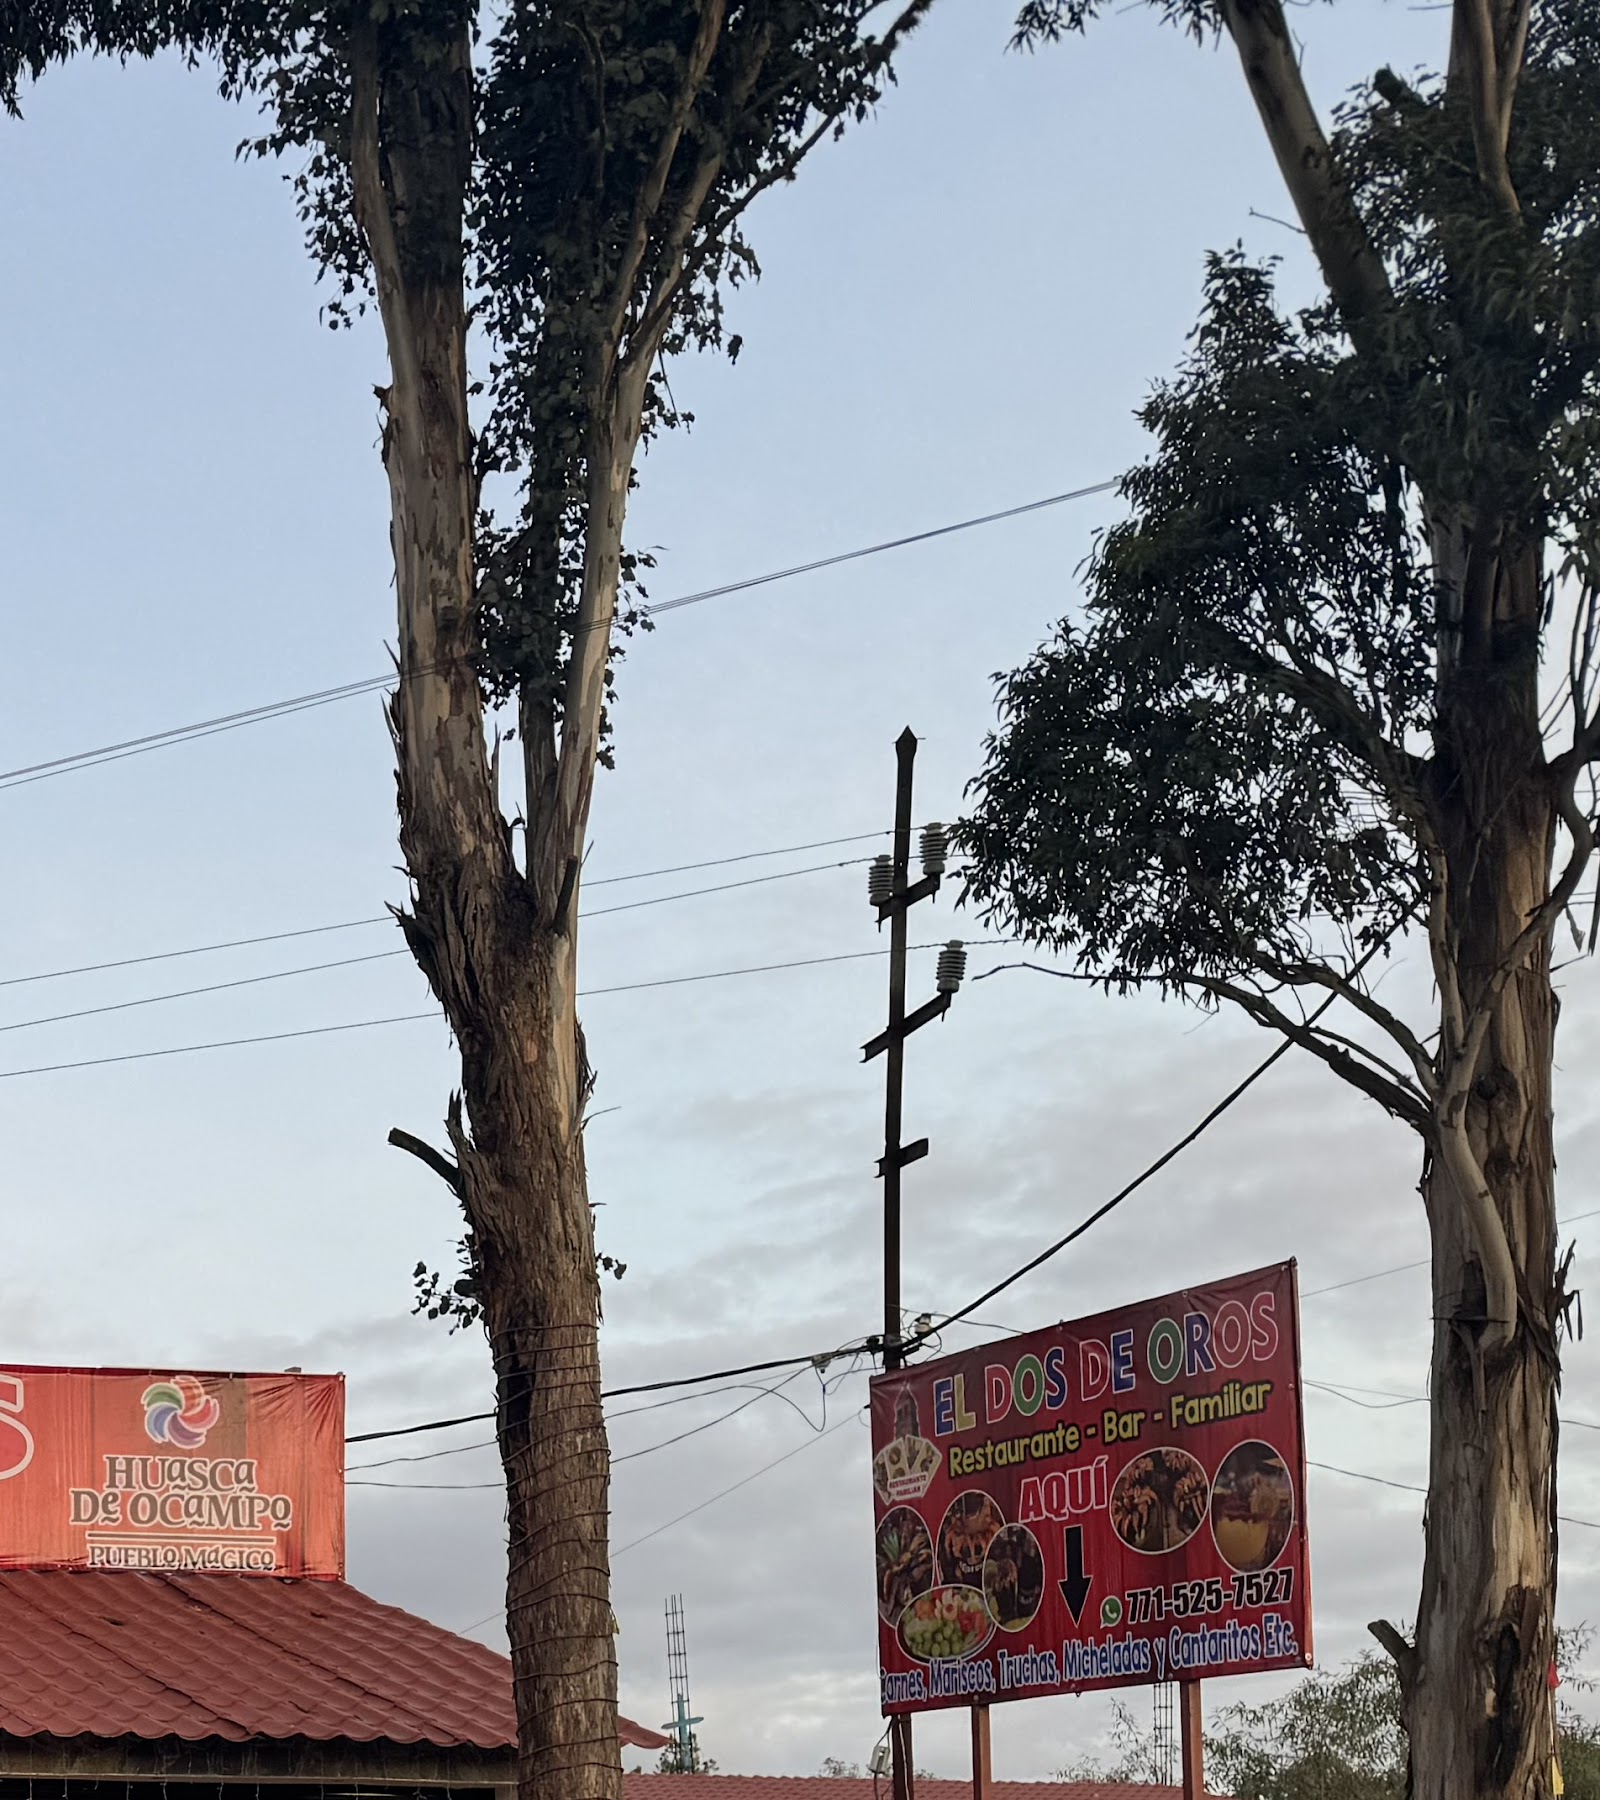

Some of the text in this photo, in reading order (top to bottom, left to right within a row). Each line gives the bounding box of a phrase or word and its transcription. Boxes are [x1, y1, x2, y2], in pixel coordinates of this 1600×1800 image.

[933, 1292, 1280, 1437] EL DOS DE OROS
[948, 1424, 1080, 1477] Restaurante
[1104, 1411, 1145, 1442] Bar
[1171, 1382, 1272, 1429] Familiar
[1019, 1455, 1110, 1524] AQUÍ
[87, 1543, 177, 1570] PUEBLO
[1127, 1568, 1294, 1624] 771-525-7527
[929, 1658, 996, 1698] Mariscos,
[999, 1644, 1060, 1690] Truchas,
[1063, 1631, 1151, 1682] Micheladas
[1154, 1637, 1166, 1680] y
[1169, 1623, 1260, 1670] Cantaritos
[1263, 1613, 1299, 1658] Etc.
